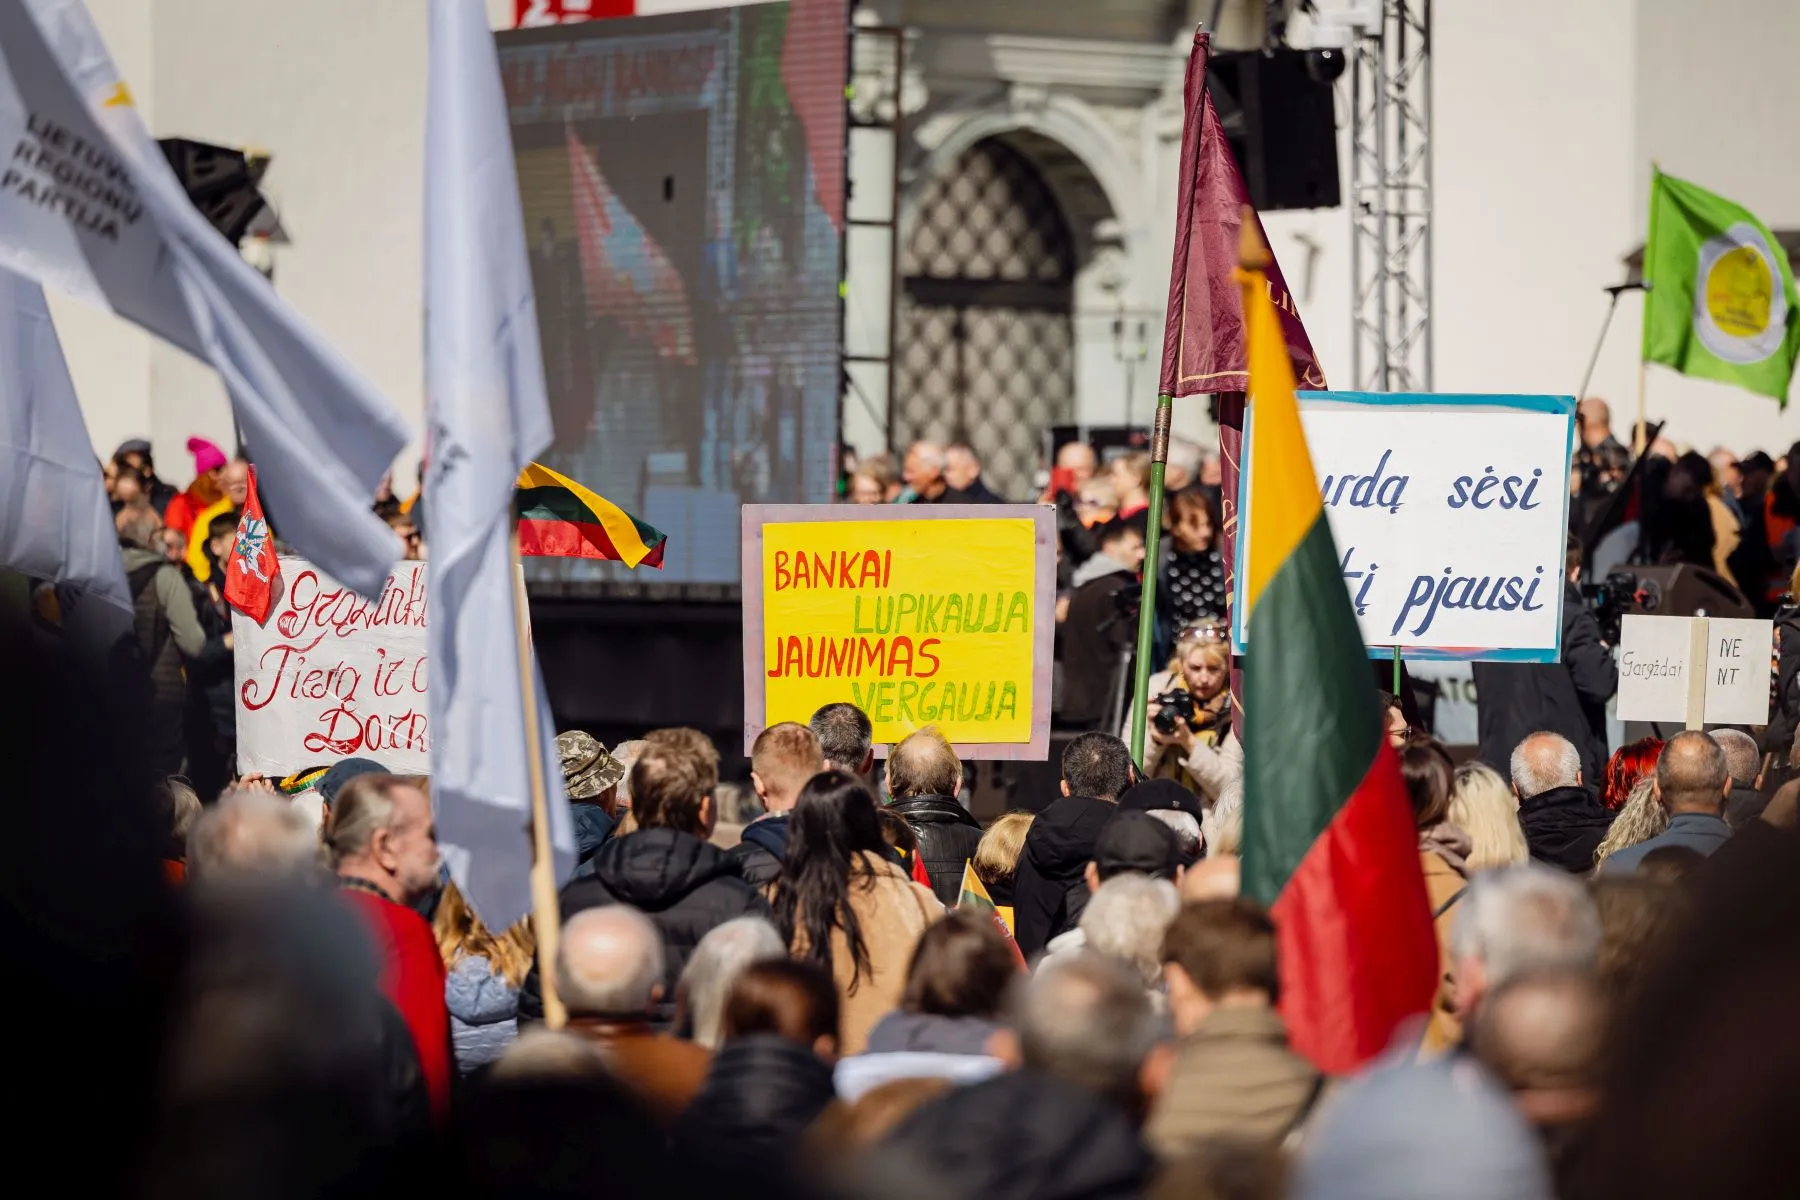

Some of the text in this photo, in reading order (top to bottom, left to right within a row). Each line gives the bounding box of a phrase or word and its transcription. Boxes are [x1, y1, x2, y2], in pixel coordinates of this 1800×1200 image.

[1447, 466, 1543, 511] sėsi
[774, 549, 892, 592] BANKAI
[853, 591, 1029, 634] LUPIKAUJA
[1390, 566, 1545, 637] pjausi
[767, 635, 942, 679] JAUNIMAS
[1719, 638, 1743, 658] NE
[1717, 668, 1740, 686] NT
[851, 680, 1018, 723] VERGAUJA
